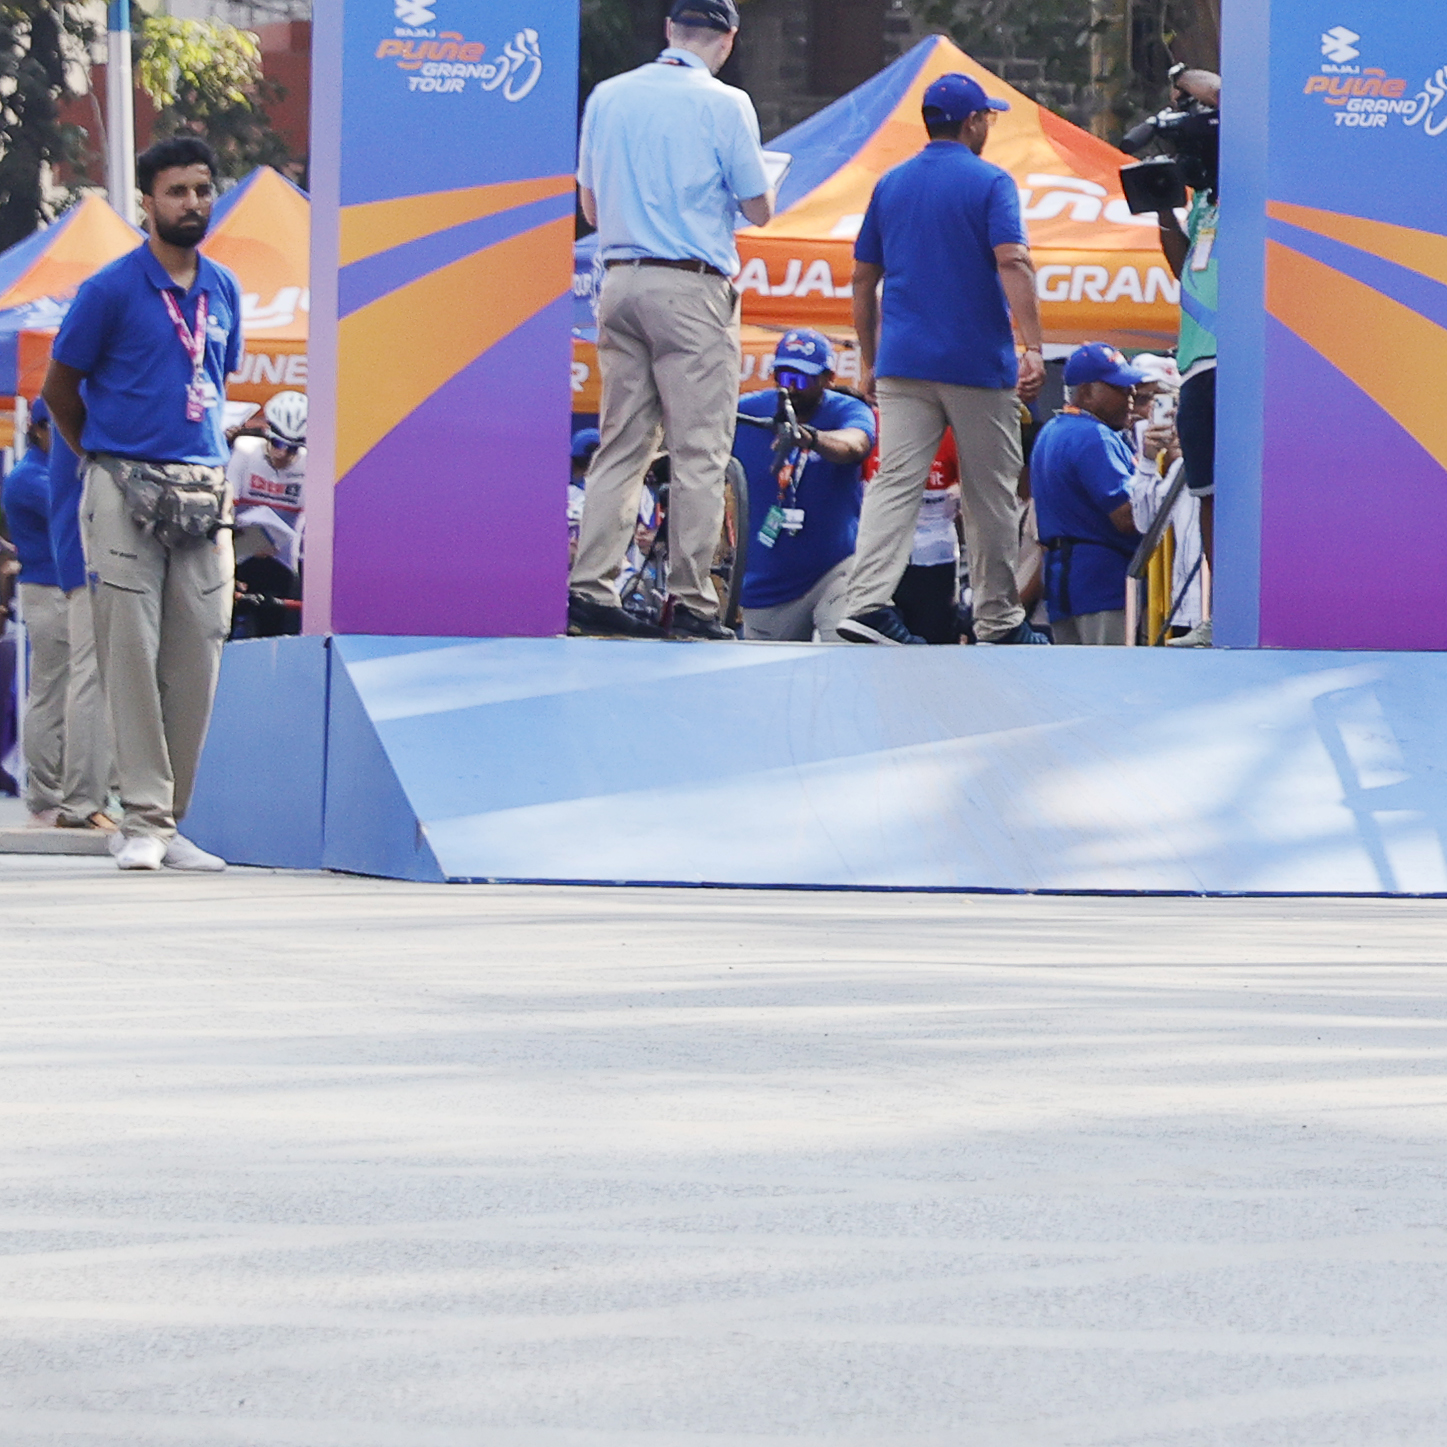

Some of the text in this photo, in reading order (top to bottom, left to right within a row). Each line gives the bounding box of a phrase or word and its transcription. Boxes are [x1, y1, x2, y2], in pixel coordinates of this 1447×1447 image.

[421, 62, 498, 80] GRAND
[408, 76, 466, 94] TOUR
[1346, 98, 1417, 114] GRAND
[1334, 112, 1388, 128] TOUR
